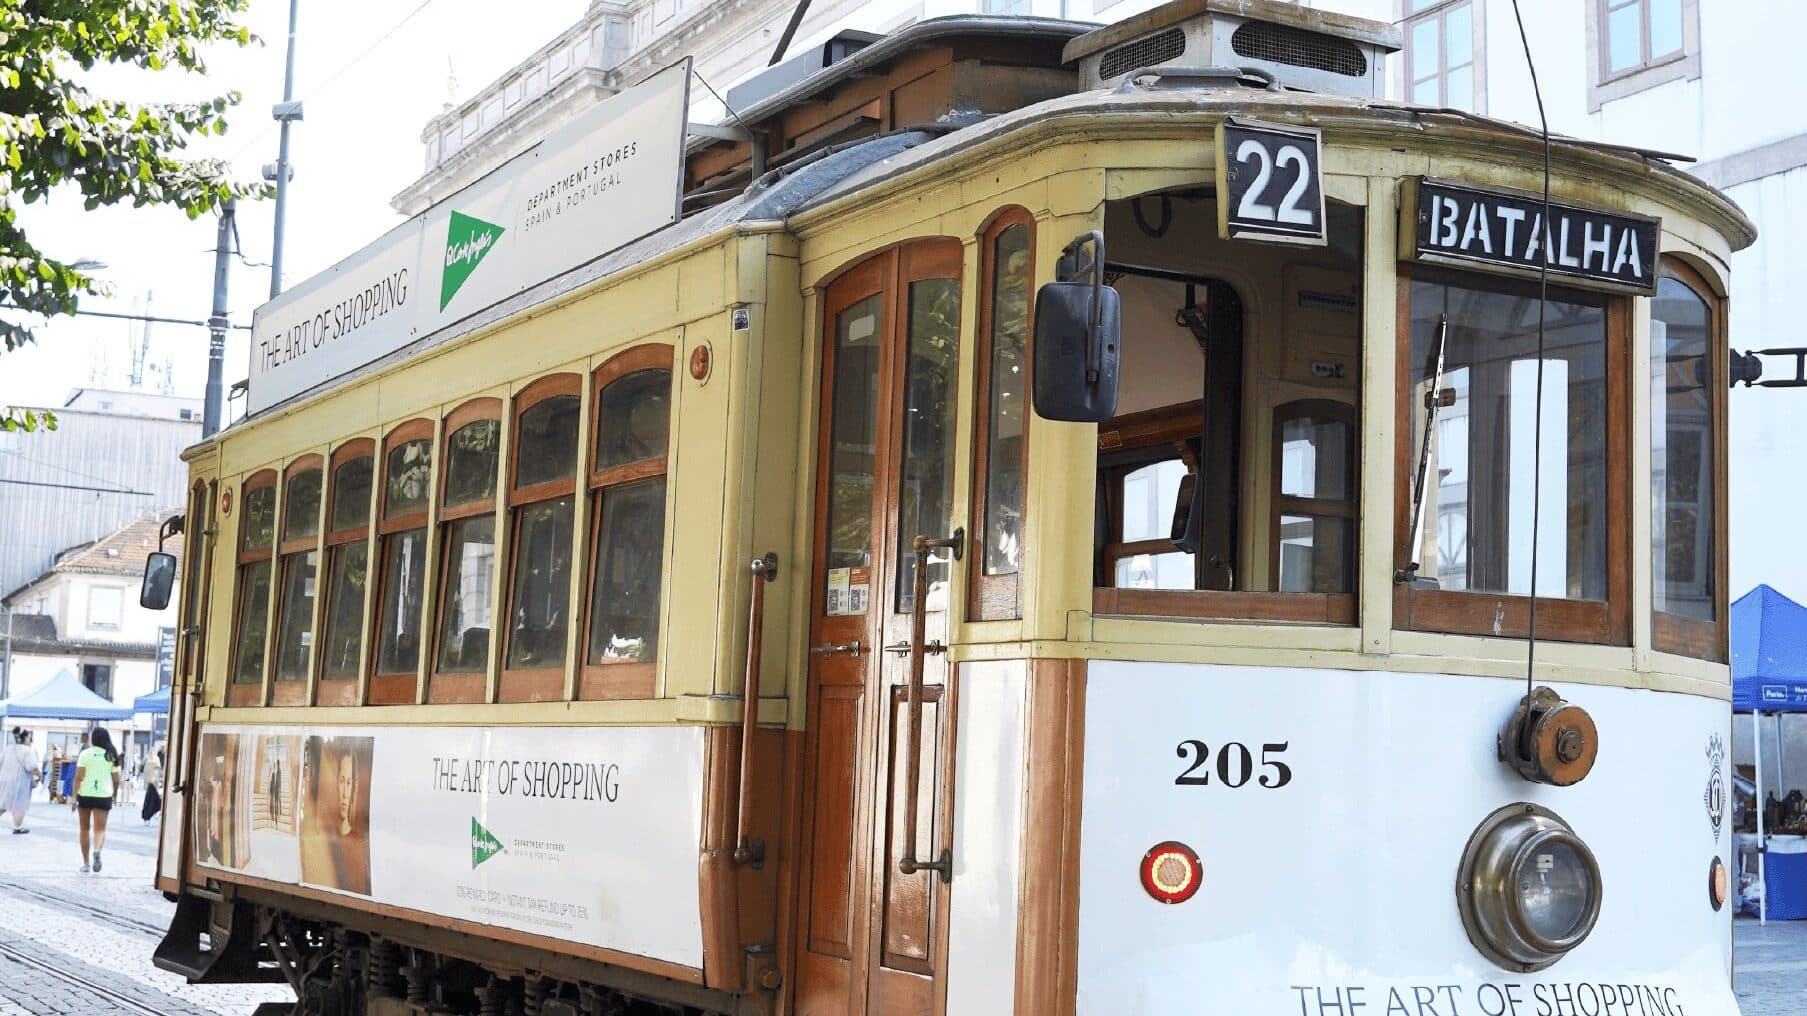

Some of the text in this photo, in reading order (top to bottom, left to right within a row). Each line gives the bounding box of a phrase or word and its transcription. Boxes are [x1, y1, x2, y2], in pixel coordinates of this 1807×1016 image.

[525, 172, 621, 231] SPAIN & PORTUGAL
[527, 141, 637, 211] DEPARTMENT STORES
[1237, 139, 1314, 225] 22
[1429, 195, 1643, 278] BATALHA
[260, 268, 408, 374] THE ART OF SHOPPING
[433, 757, 619, 803] THE ART OF SHOPPING
[1174, 739, 1292, 789] 205
